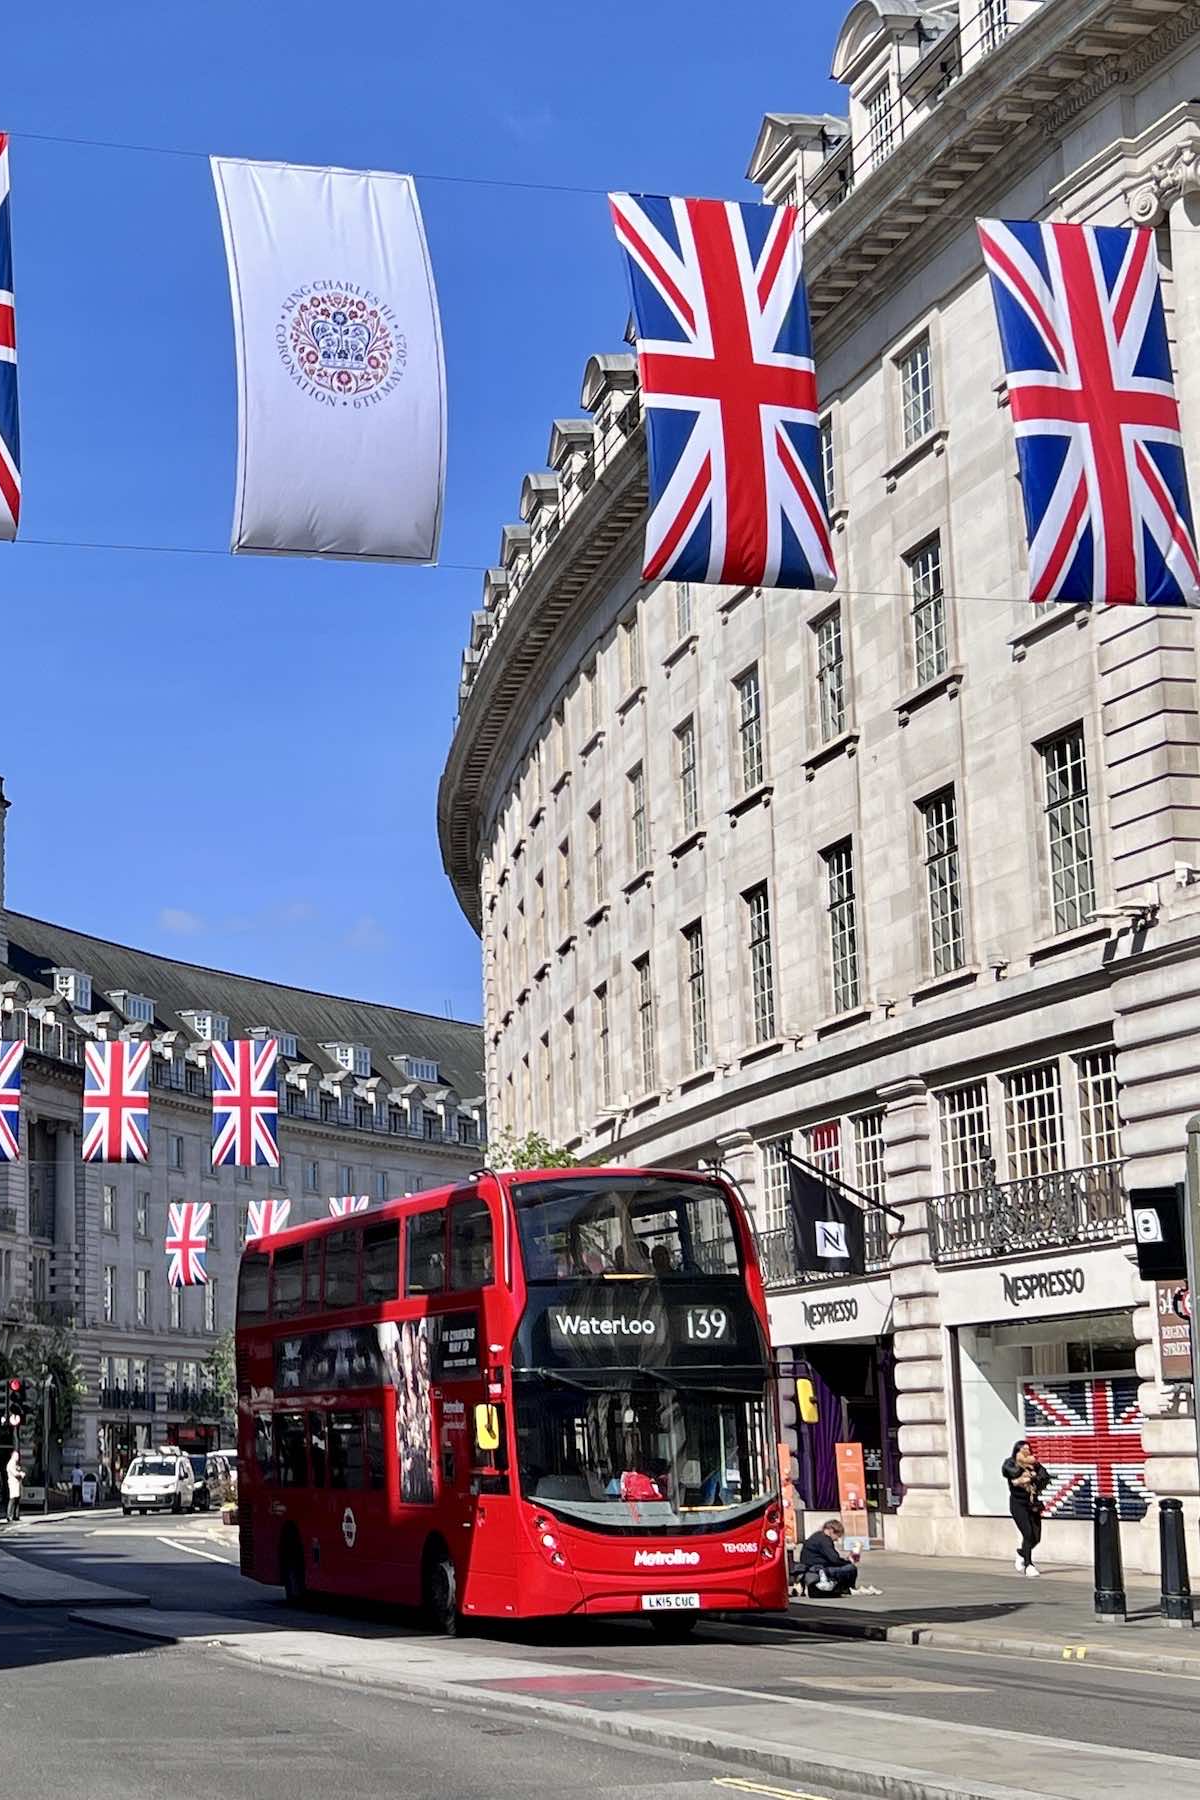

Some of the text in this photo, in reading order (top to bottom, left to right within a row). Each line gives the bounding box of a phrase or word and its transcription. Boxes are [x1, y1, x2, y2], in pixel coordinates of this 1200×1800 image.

[281, 279, 396, 321] KING CHARLES III
[275, 323, 338, 407] CORONATION
[353, 334, 408, 409] 6TH MAY 2023
[999, 1267, 1085, 1307] NESPRESSO
[555, 1314, 656, 1335] Waterloo
[687, 1308, 727, 1339] 139
[801, 1297, 858, 1330] NESPRESSO
[634, 1548, 700, 1566] Metroline
[648, 1596, 672, 1608] LK15
